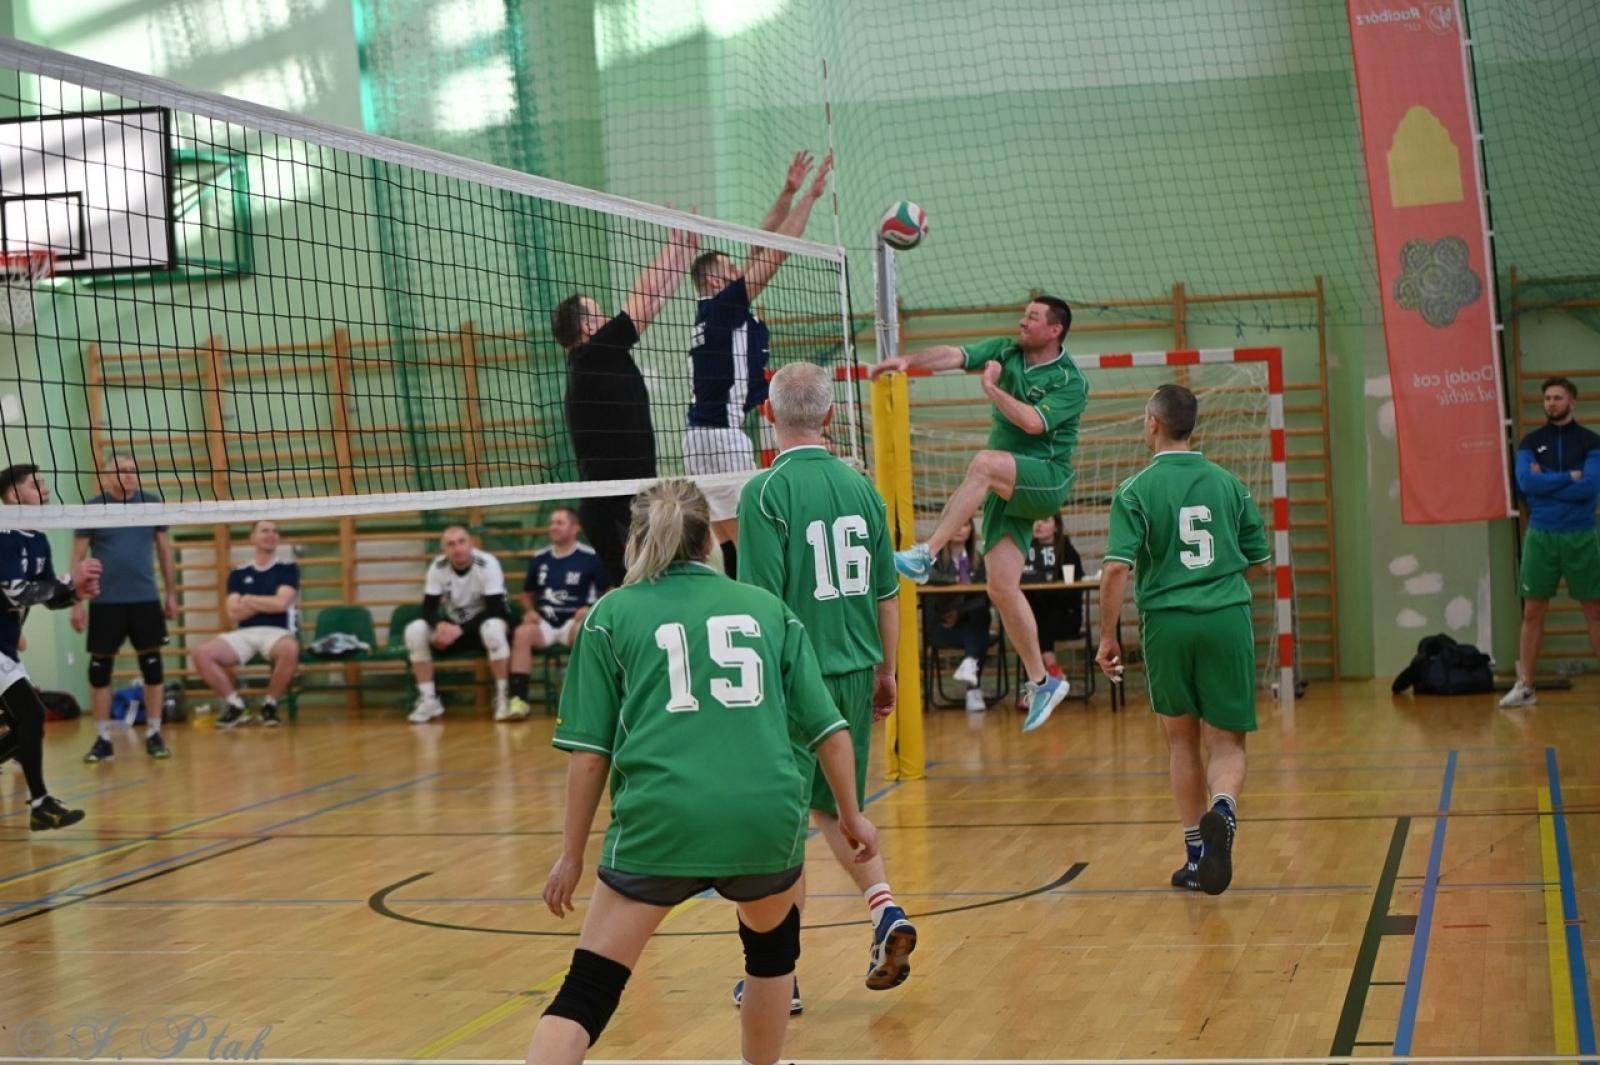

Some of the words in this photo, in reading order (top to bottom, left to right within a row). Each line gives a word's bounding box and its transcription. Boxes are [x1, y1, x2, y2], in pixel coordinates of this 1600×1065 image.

[806, 514, 871, 601] 16
[1041, 546, 1056, 566] 15
[1179, 505, 1214, 570] 5
[655, 614, 764, 712] 15
